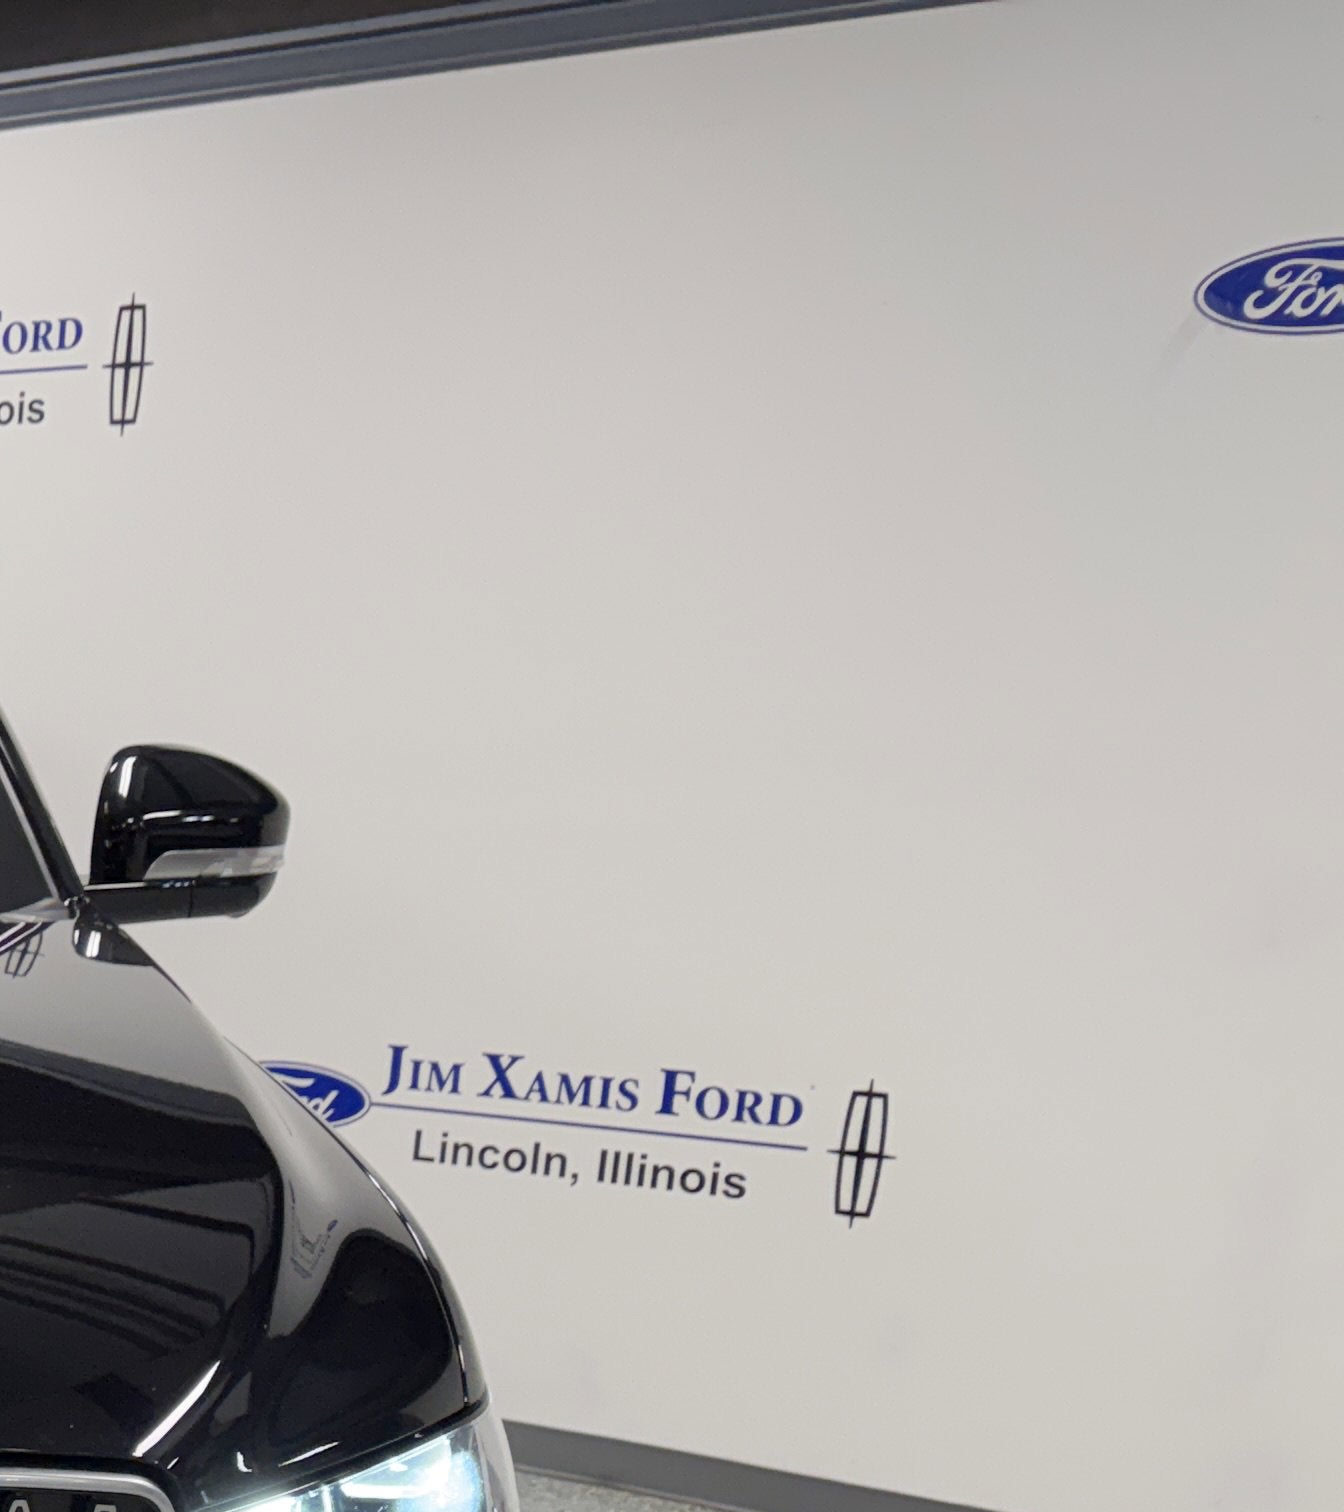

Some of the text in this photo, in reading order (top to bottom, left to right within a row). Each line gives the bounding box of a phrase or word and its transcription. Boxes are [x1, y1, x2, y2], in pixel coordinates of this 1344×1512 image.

[1243, 258, 1344, 319] For
[381, 1044, 465, 1097] JIM
[477, 1053, 639, 1113] XAMIS
[655, 1068, 804, 1128] FORD
[412, 1129, 746, 1199] Lincoln, Illinois
